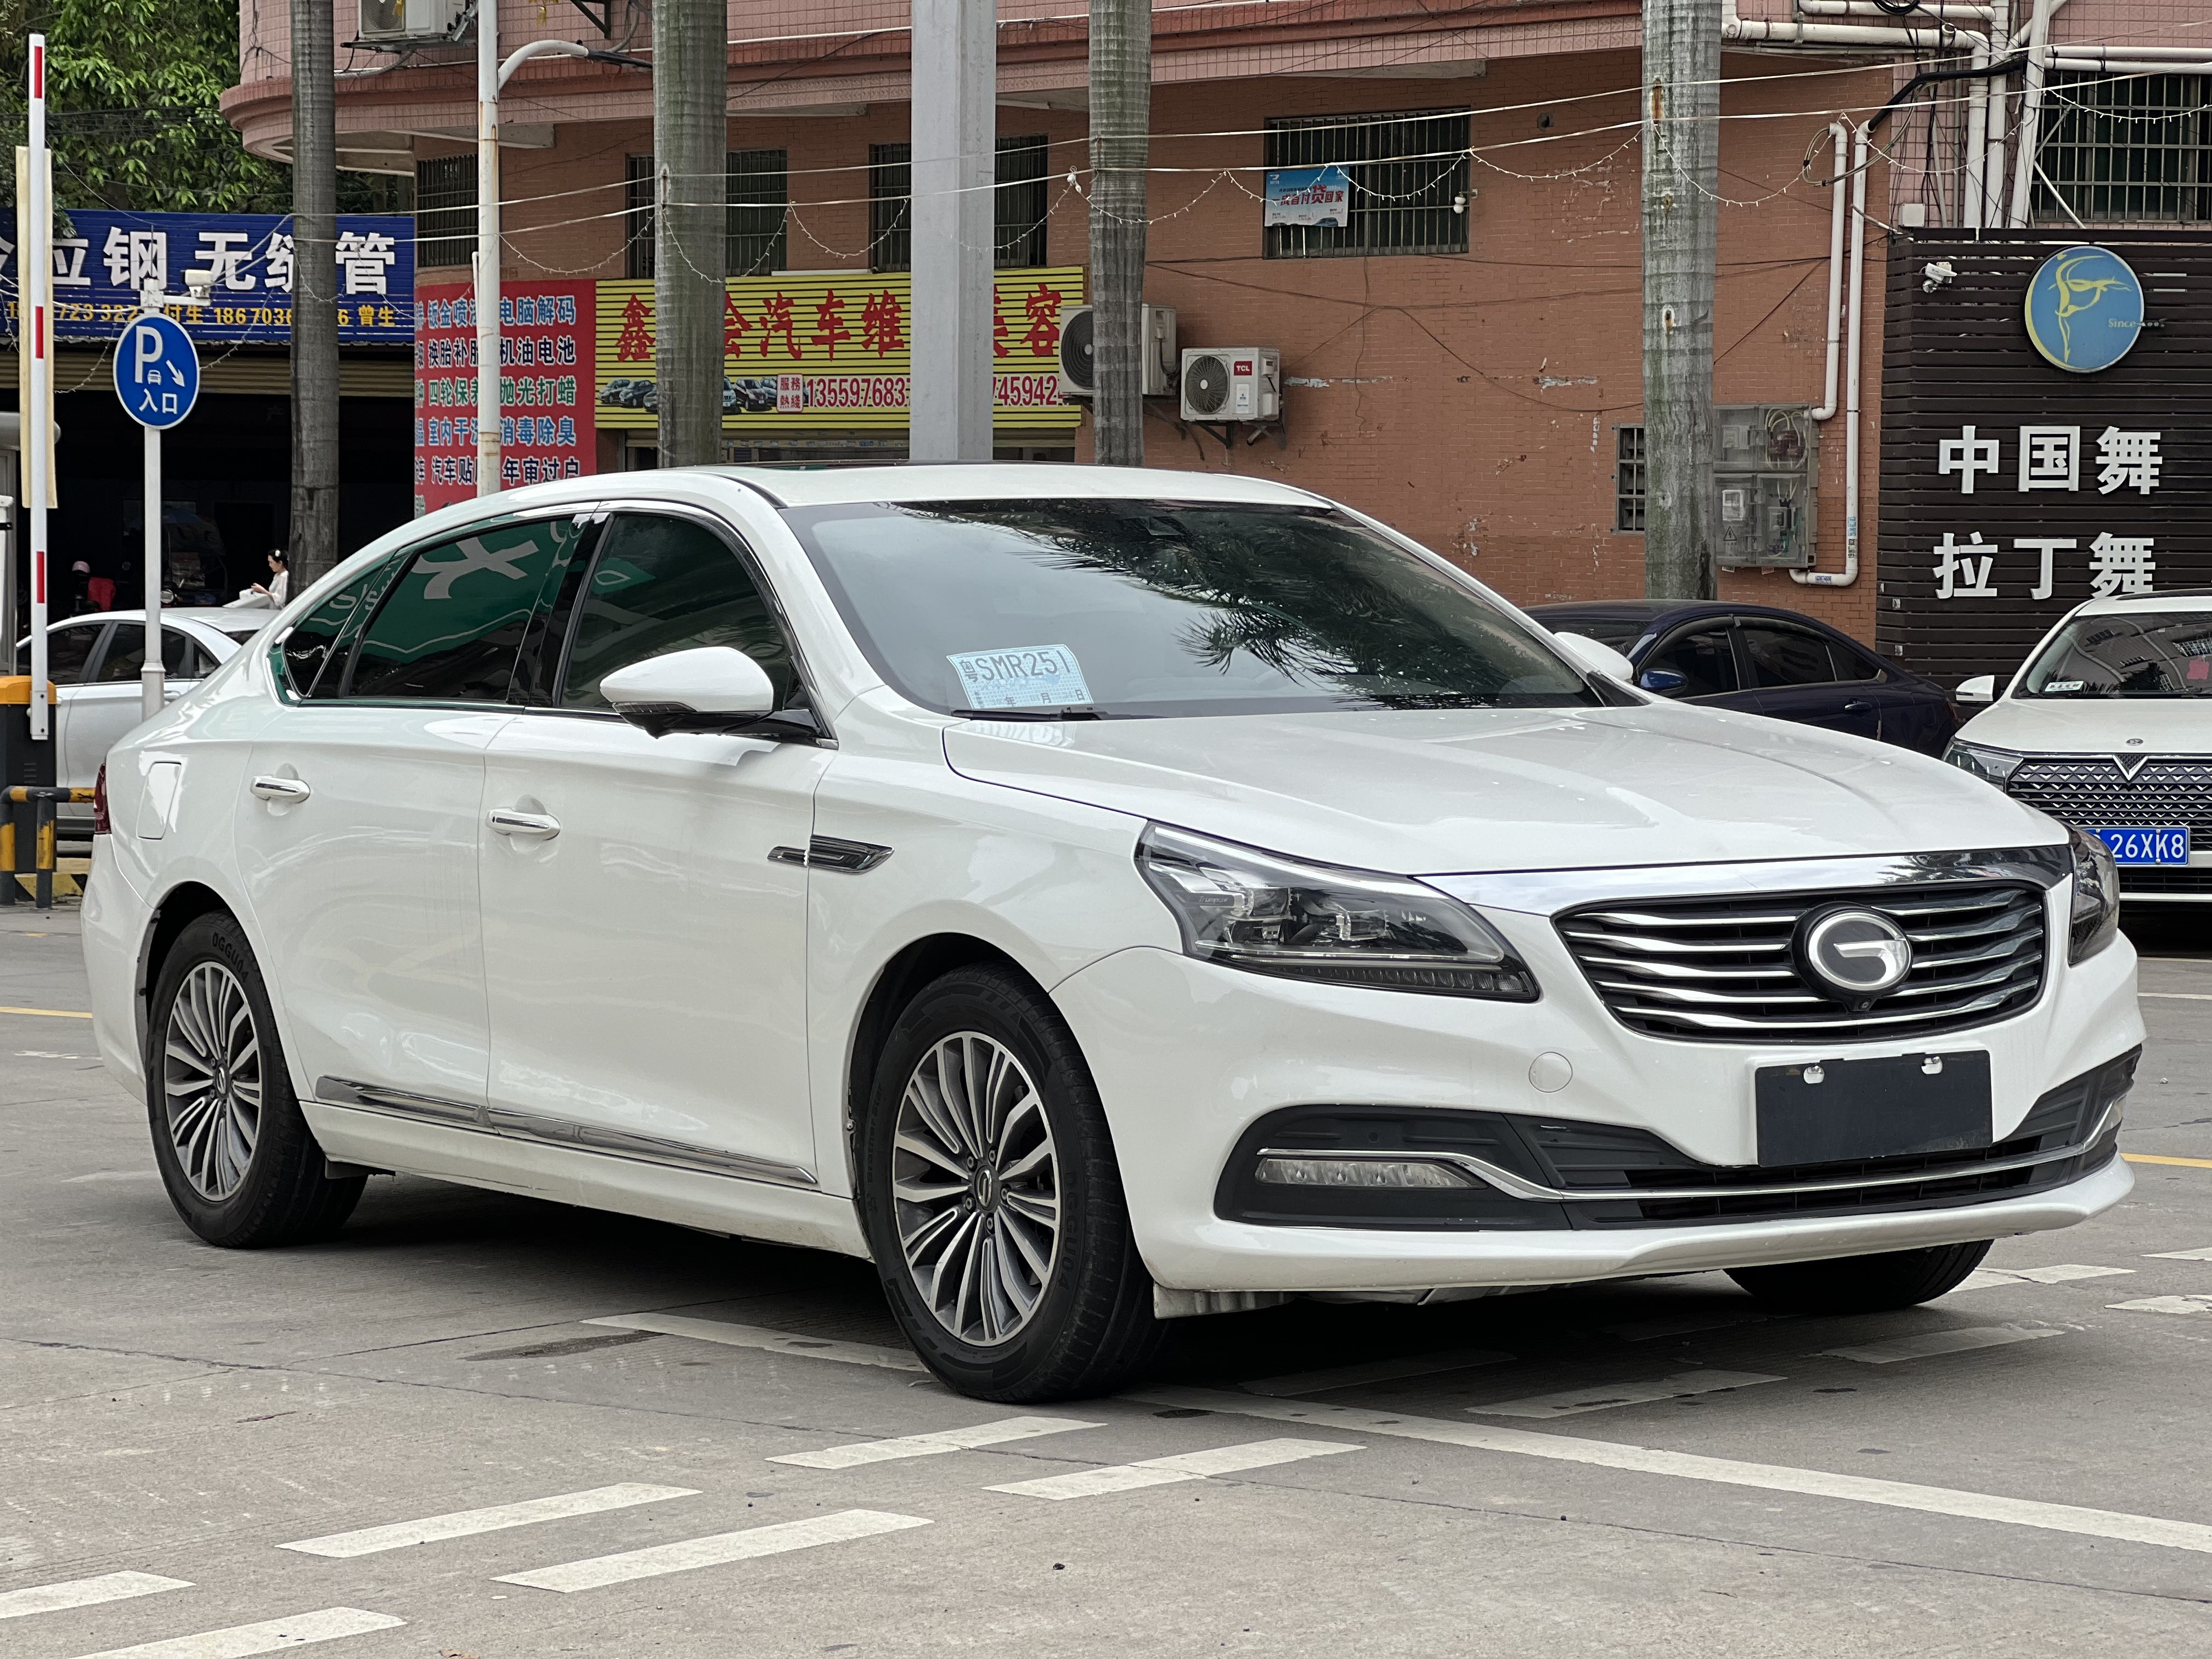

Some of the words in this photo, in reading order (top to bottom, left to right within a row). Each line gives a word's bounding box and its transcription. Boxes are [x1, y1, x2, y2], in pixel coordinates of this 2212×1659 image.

[358, 305, 395, 326] 曾生
[500, 295, 575, 325] 电脑解码
[2108, 318, 2136, 328] Since
[134, 325, 163, 383] P
[500, 335, 576, 366] 机油电池
[500, 375, 576, 407] 抛光打蜡
[780, 377, 801, 391] 服務
[139, 388, 178, 415] 入口
[500, 415, 576, 447] 消毒除臭
[431, 455, 477, 485] 汽车贴
[502, 456, 580, 487] 年审过户
[1938, 425, 2163, 495] 中国舞
[1932, 531, 2156, 599] 拉丁舞
